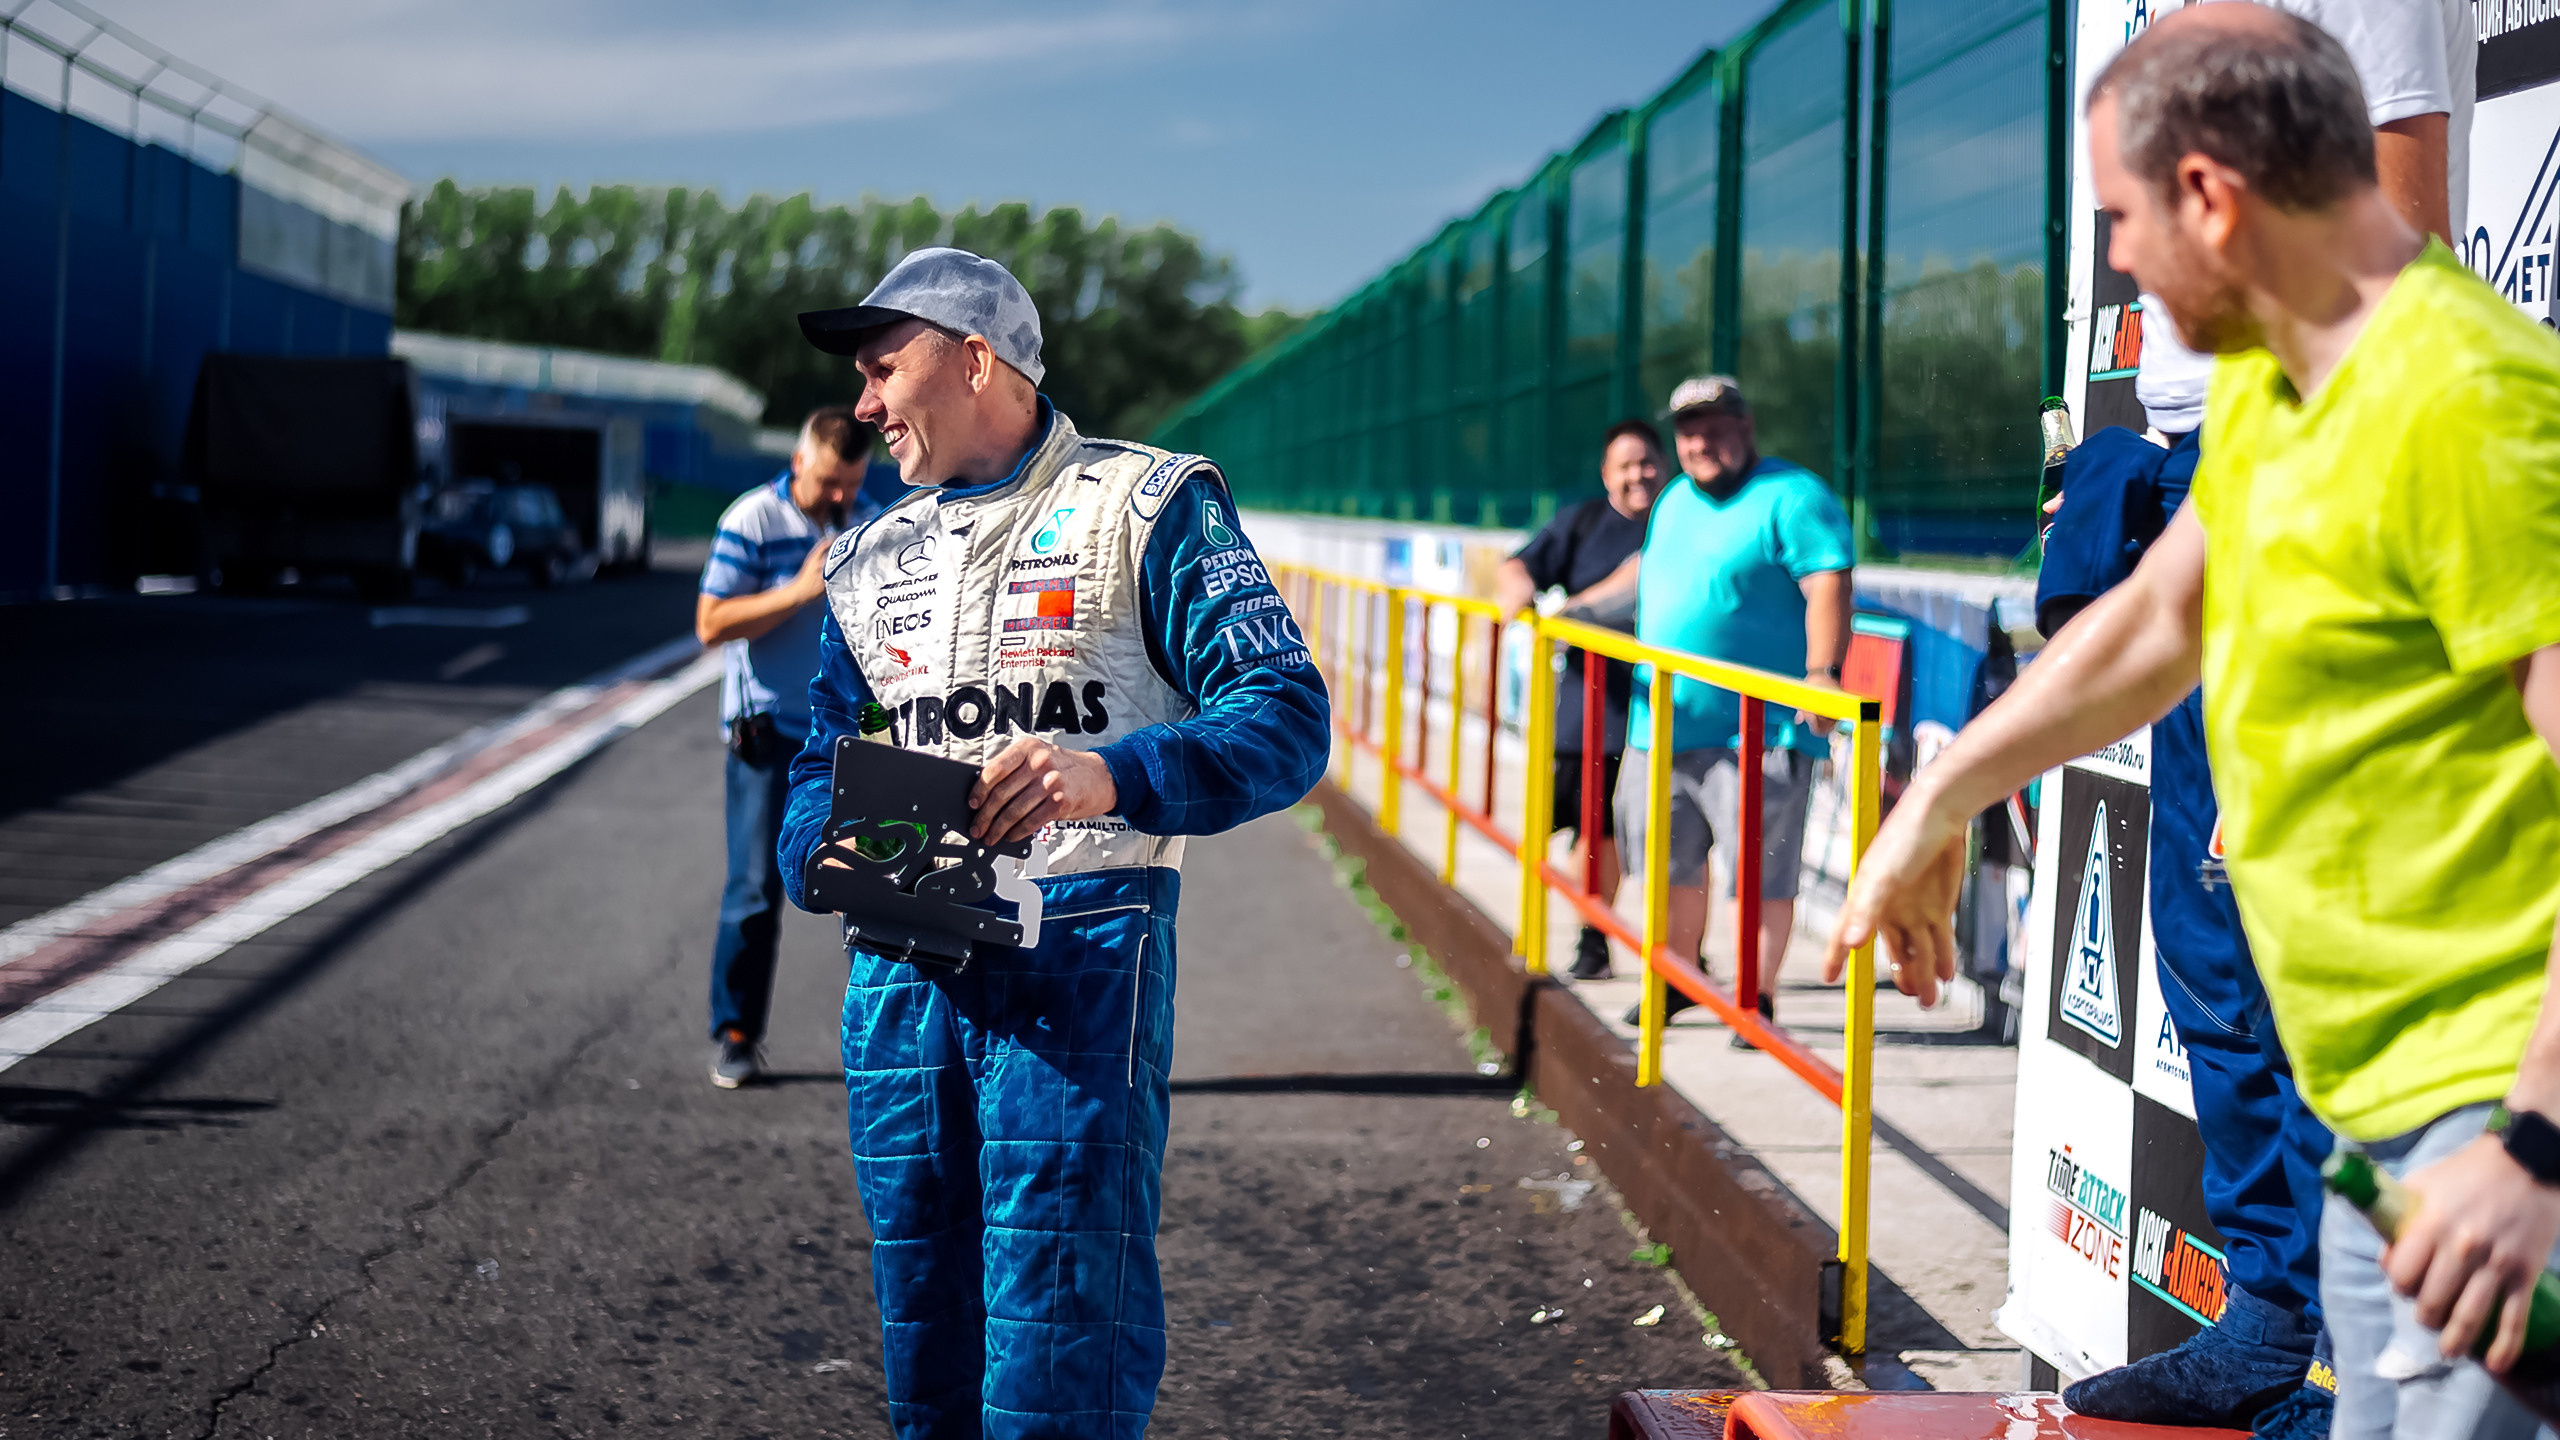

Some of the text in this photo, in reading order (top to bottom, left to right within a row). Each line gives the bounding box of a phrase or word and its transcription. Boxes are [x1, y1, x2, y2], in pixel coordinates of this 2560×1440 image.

[1012, 553, 1079, 571] PETRONAS
[1011, 578, 1072, 593] TOMMY
[1219, 595, 1285, 621] BOSE
[876, 609, 932, 640] INEOS
[1006, 617, 1069, 631] HILFIGER
[1222, 615, 1306, 663] IWC
[1000, 648, 1075, 659] Hewlett Packard
[1000, 658, 1046, 669] Enterprise
[880, 665, 929, 688] CROWDSTRIKE
[2071, 1214, 2122, 1280] ZONE
